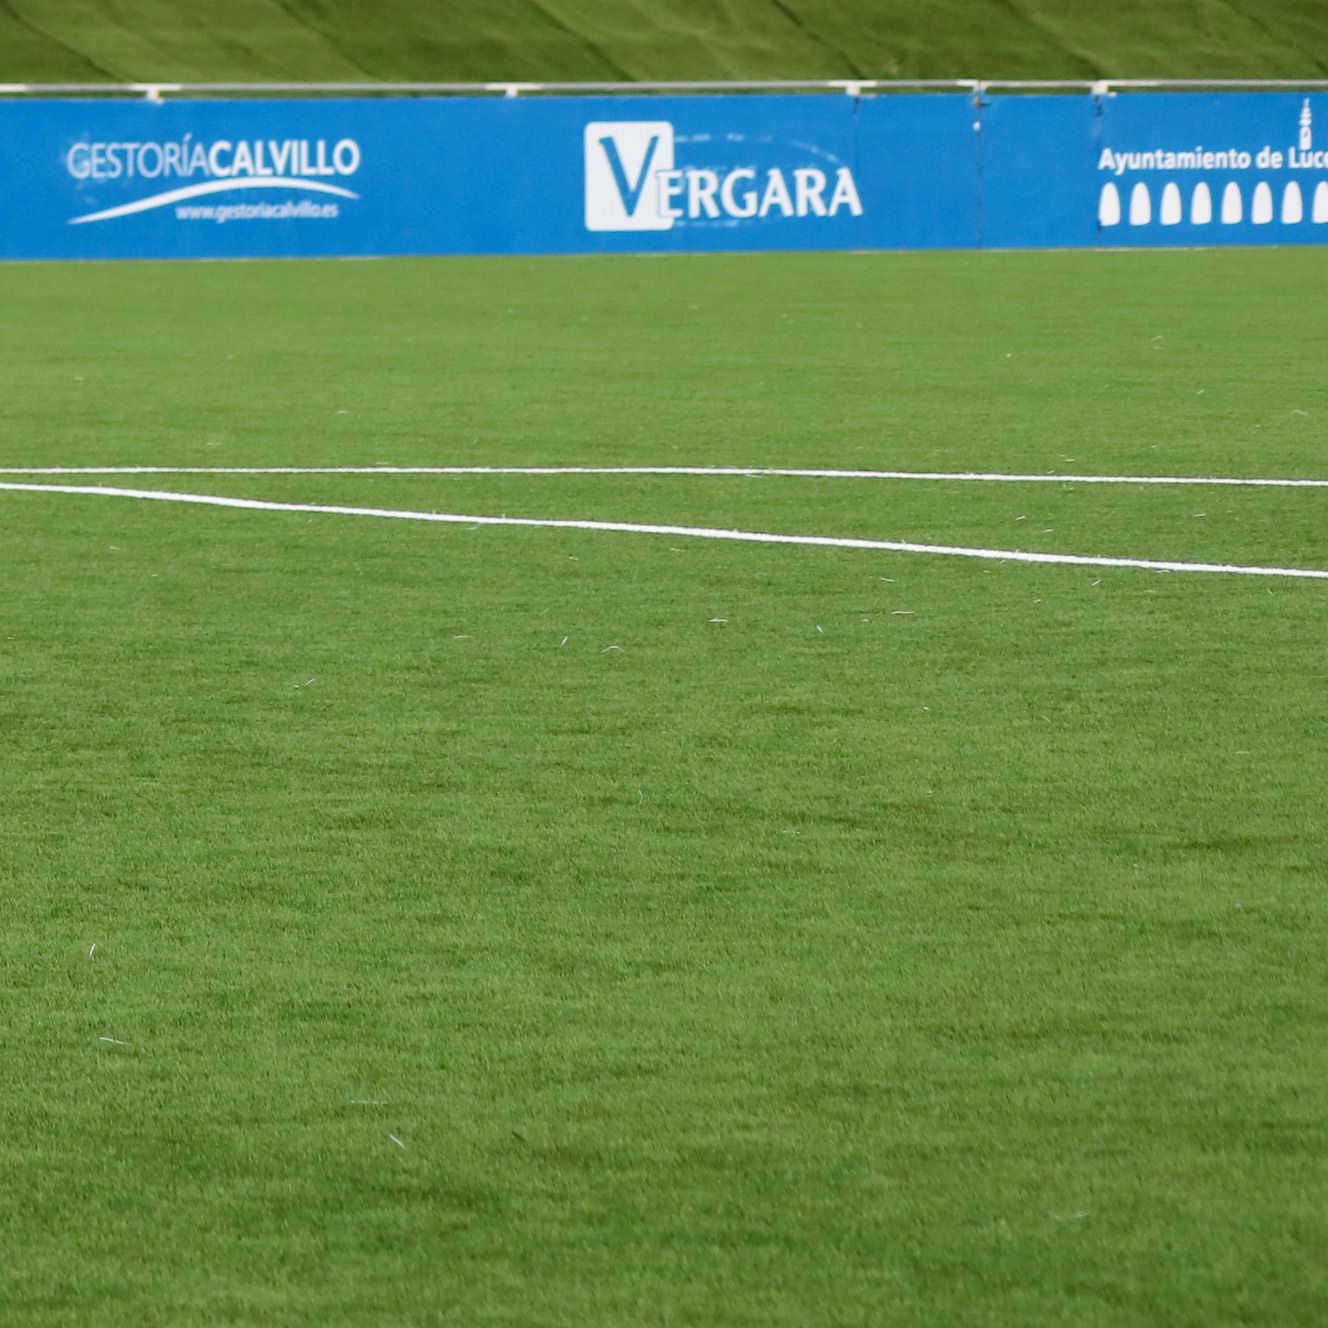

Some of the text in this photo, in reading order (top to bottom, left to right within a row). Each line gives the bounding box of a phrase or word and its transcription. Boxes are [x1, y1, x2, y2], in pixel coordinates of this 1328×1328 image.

[1098, 146, 1252, 176] Ayuntamiento
[1256, 146, 1284, 169] de
[598, 135, 864, 219] VERGARA
[174, 199, 339, 224] www.gestoriacalvillo.es
